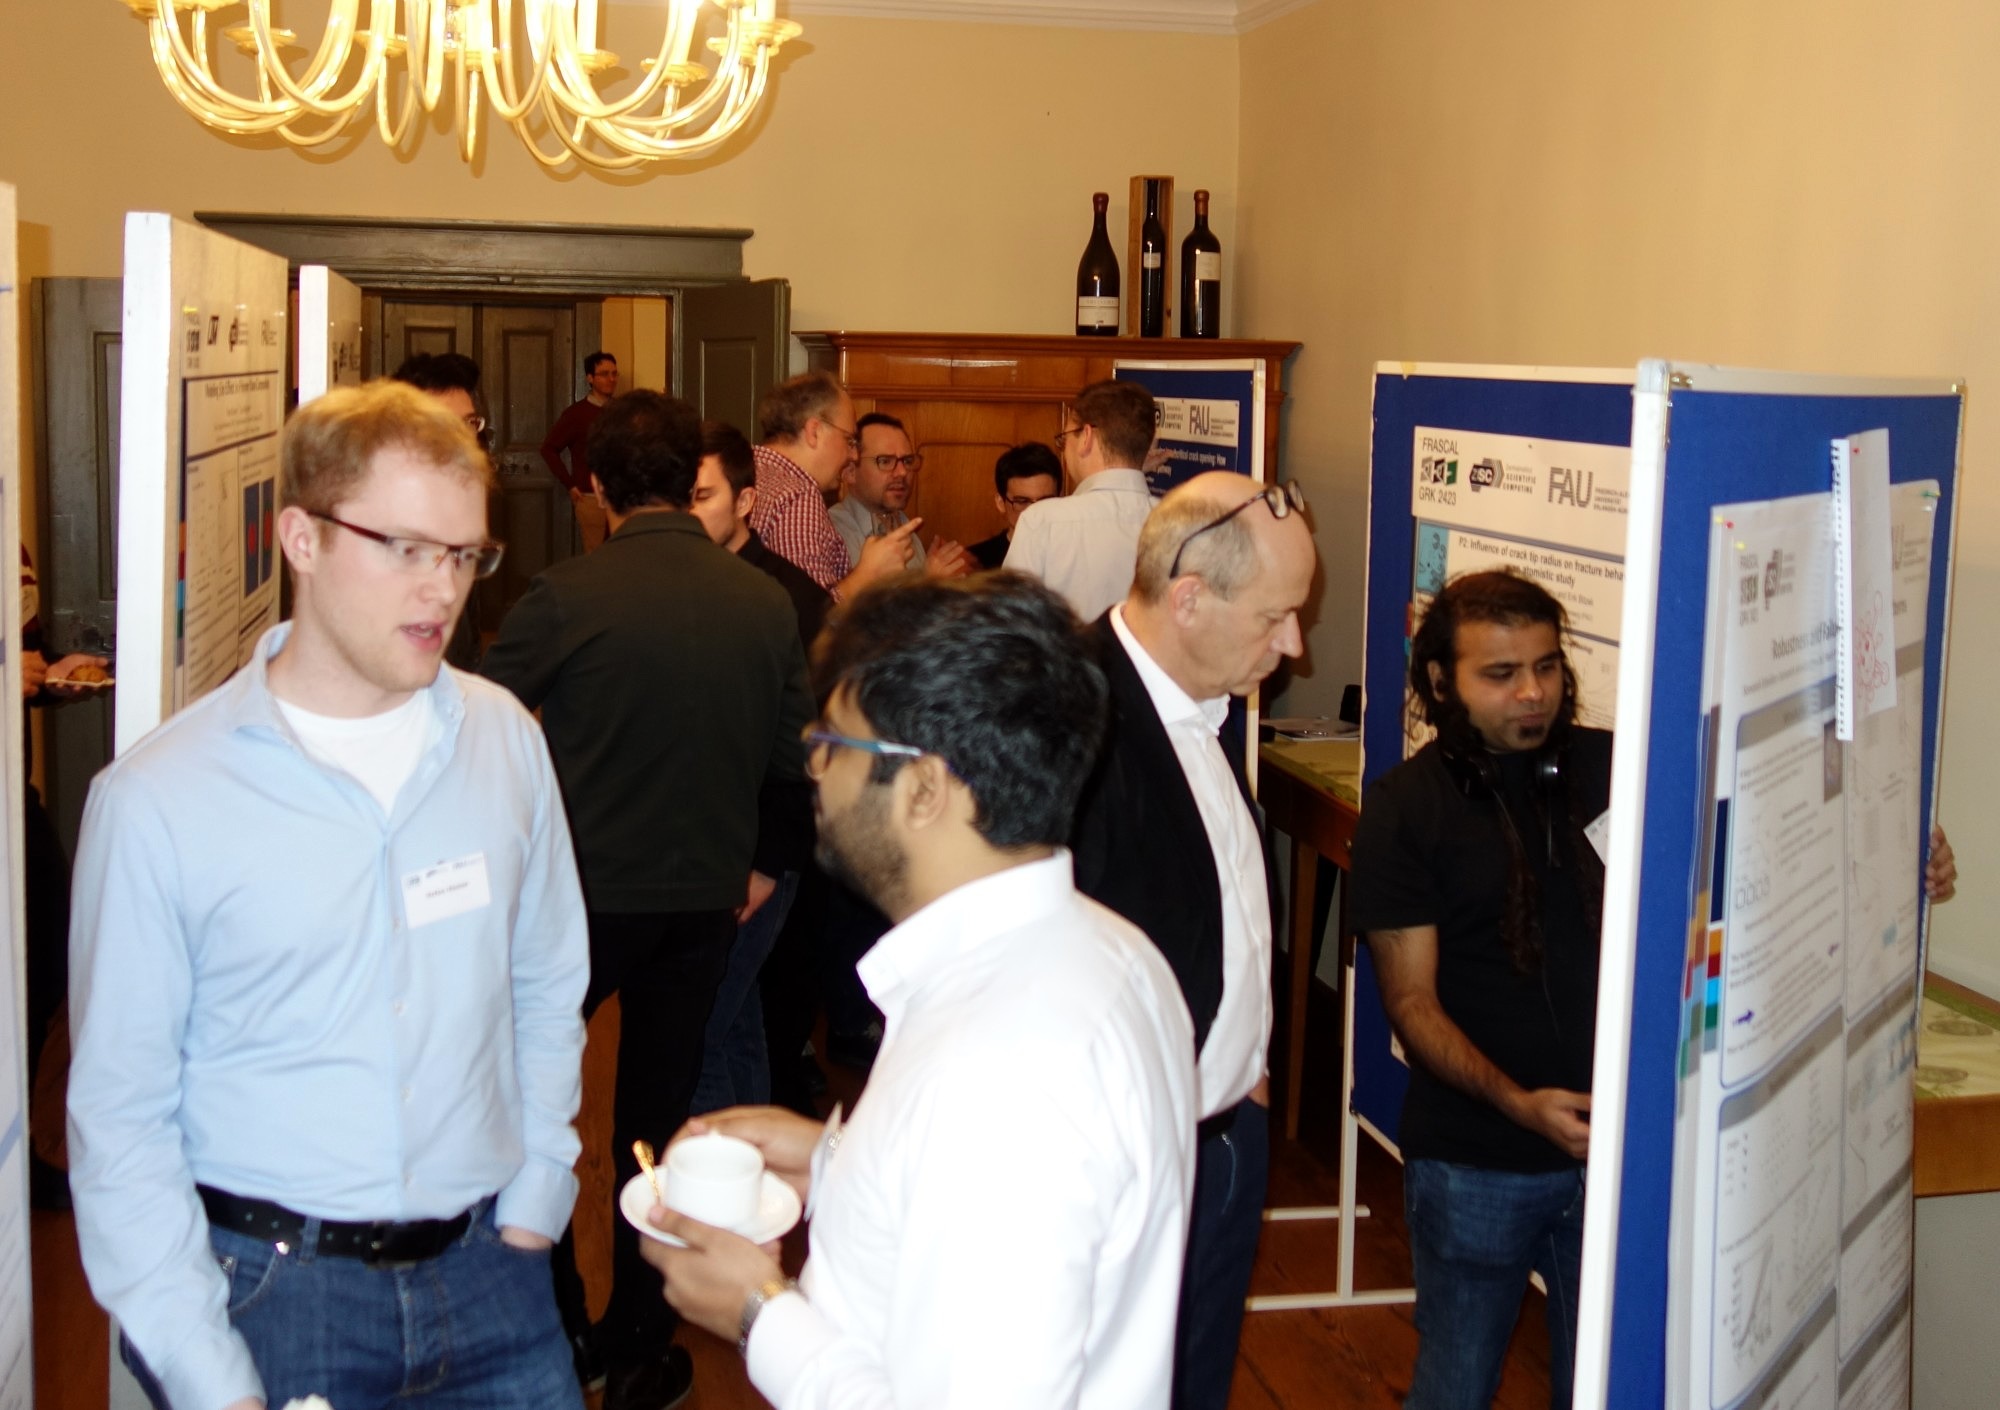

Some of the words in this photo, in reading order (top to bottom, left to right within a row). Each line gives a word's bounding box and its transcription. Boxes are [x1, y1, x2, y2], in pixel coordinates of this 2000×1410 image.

[1189, 405, 1211, 436] FAU
[1422, 437, 1459, 455] FRASCAL
[1419, 486, 1436, 502] GRK
[1438, 489, 1457, 506] 2423
[1548, 466, 1594, 508] FAU
[1470, 539, 1499, 555] Influence
[1501, 545, 1508, 556] of
[1509, 546, 1527, 560] crack
[1529, 550, 1539, 566] tip
[1540, 552, 1563, 568] radius
[1564, 559, 1574, 569] on
[1575, 559, 1603, 576] fracture
[1523, 566, 1554, 581] atomistic
[1555, 573, 1576, 588] study
